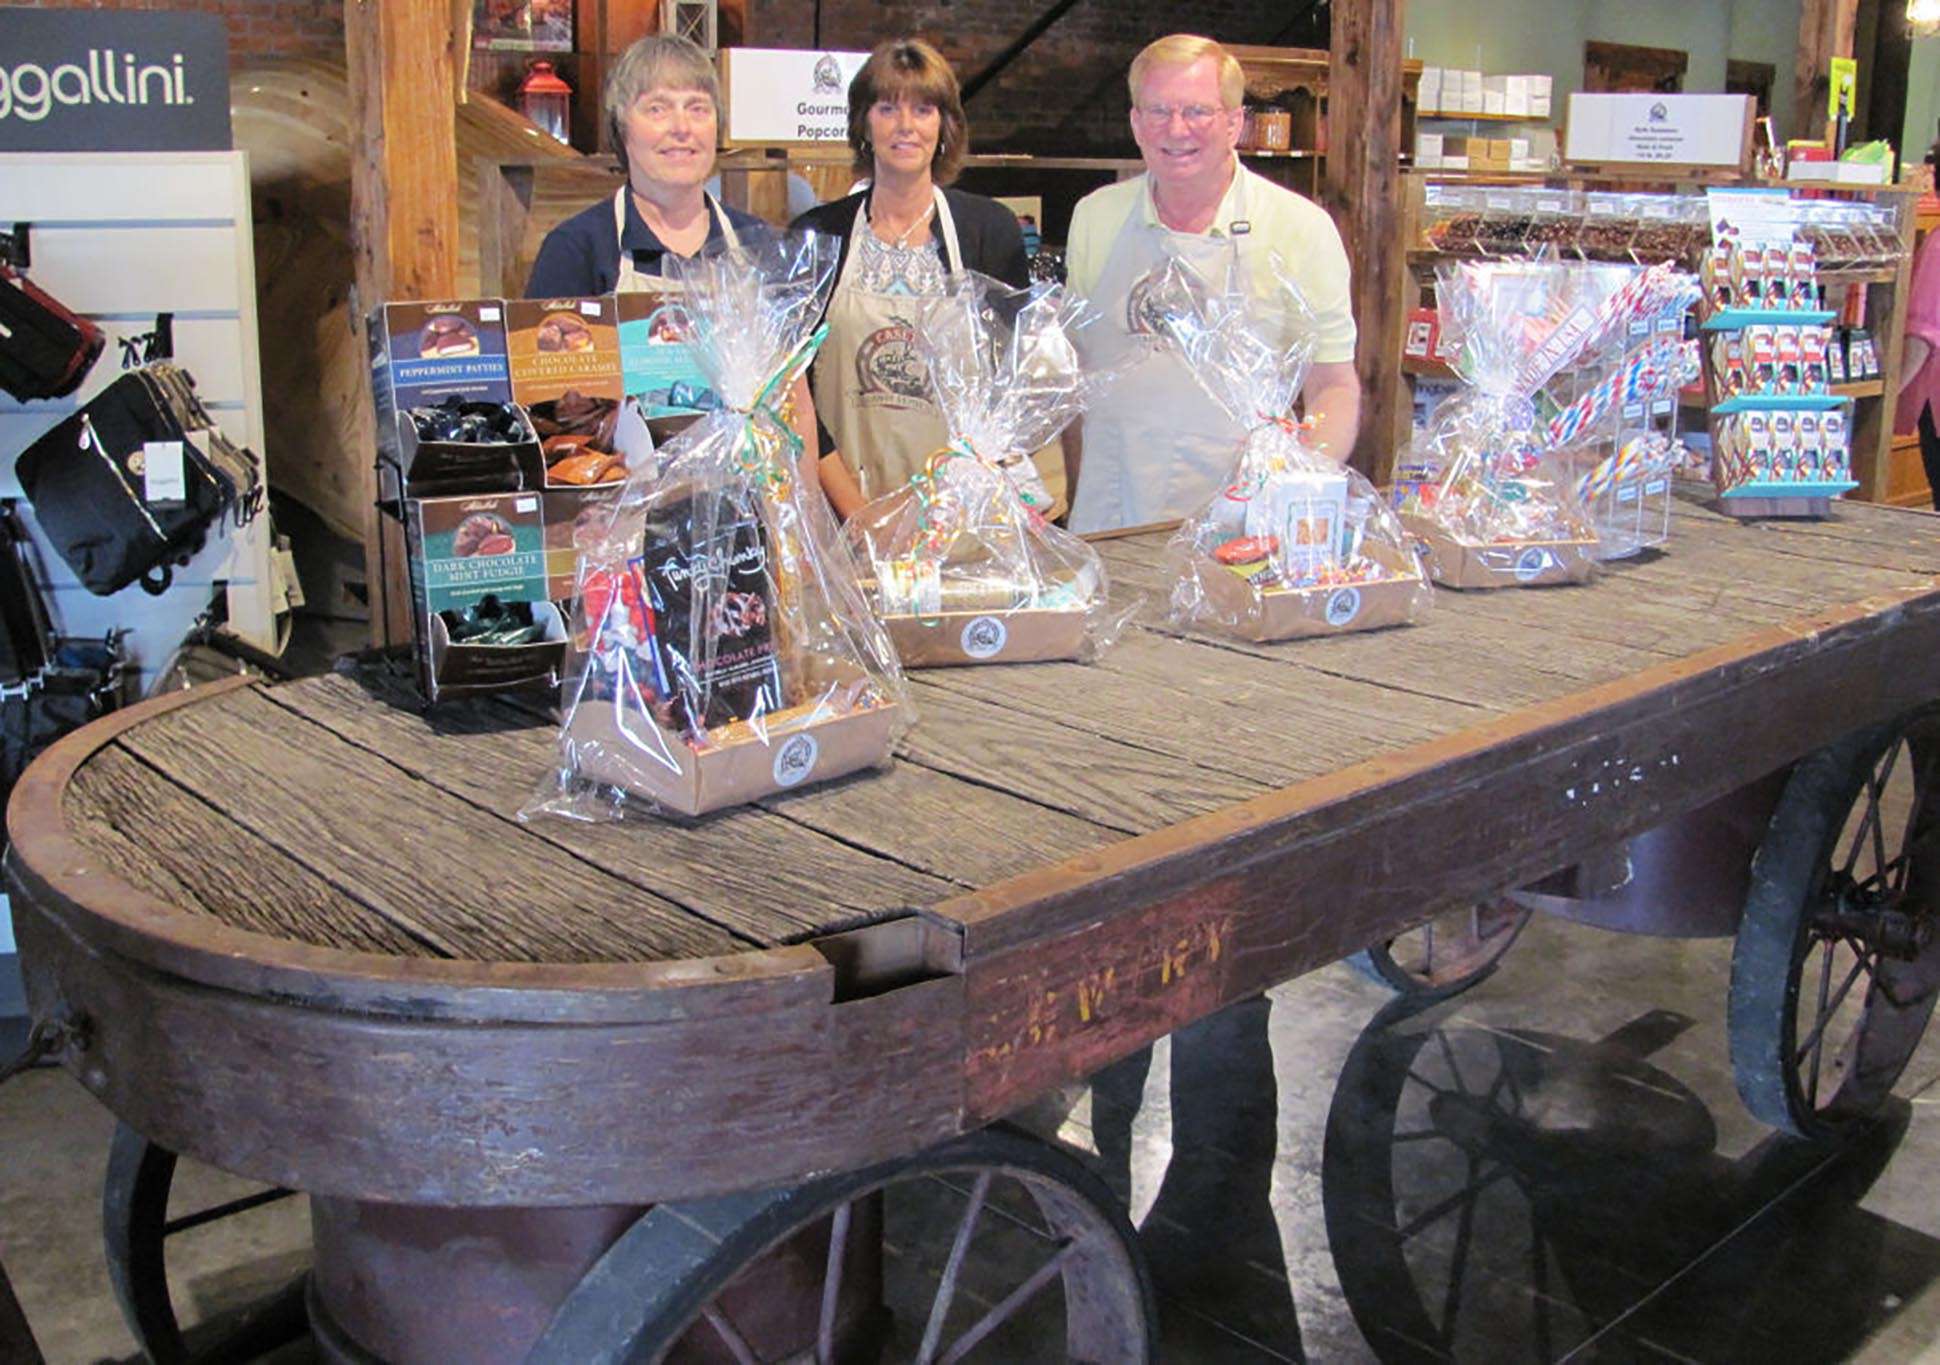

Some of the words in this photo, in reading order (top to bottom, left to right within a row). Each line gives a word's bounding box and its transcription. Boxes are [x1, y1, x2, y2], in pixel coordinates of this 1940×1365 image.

[797, 124, 848, 140] Popcor
[400, 364, 463, 378] PEPPERMINT
[466, 361, 503, 374] PATTIES
[432, 562, 465, 573] DARK
[468, 555, 536, 570] CHOCOLATE
[449, 570, 479, 581] MINT
[481, 565, 524, 578] FUDGE
